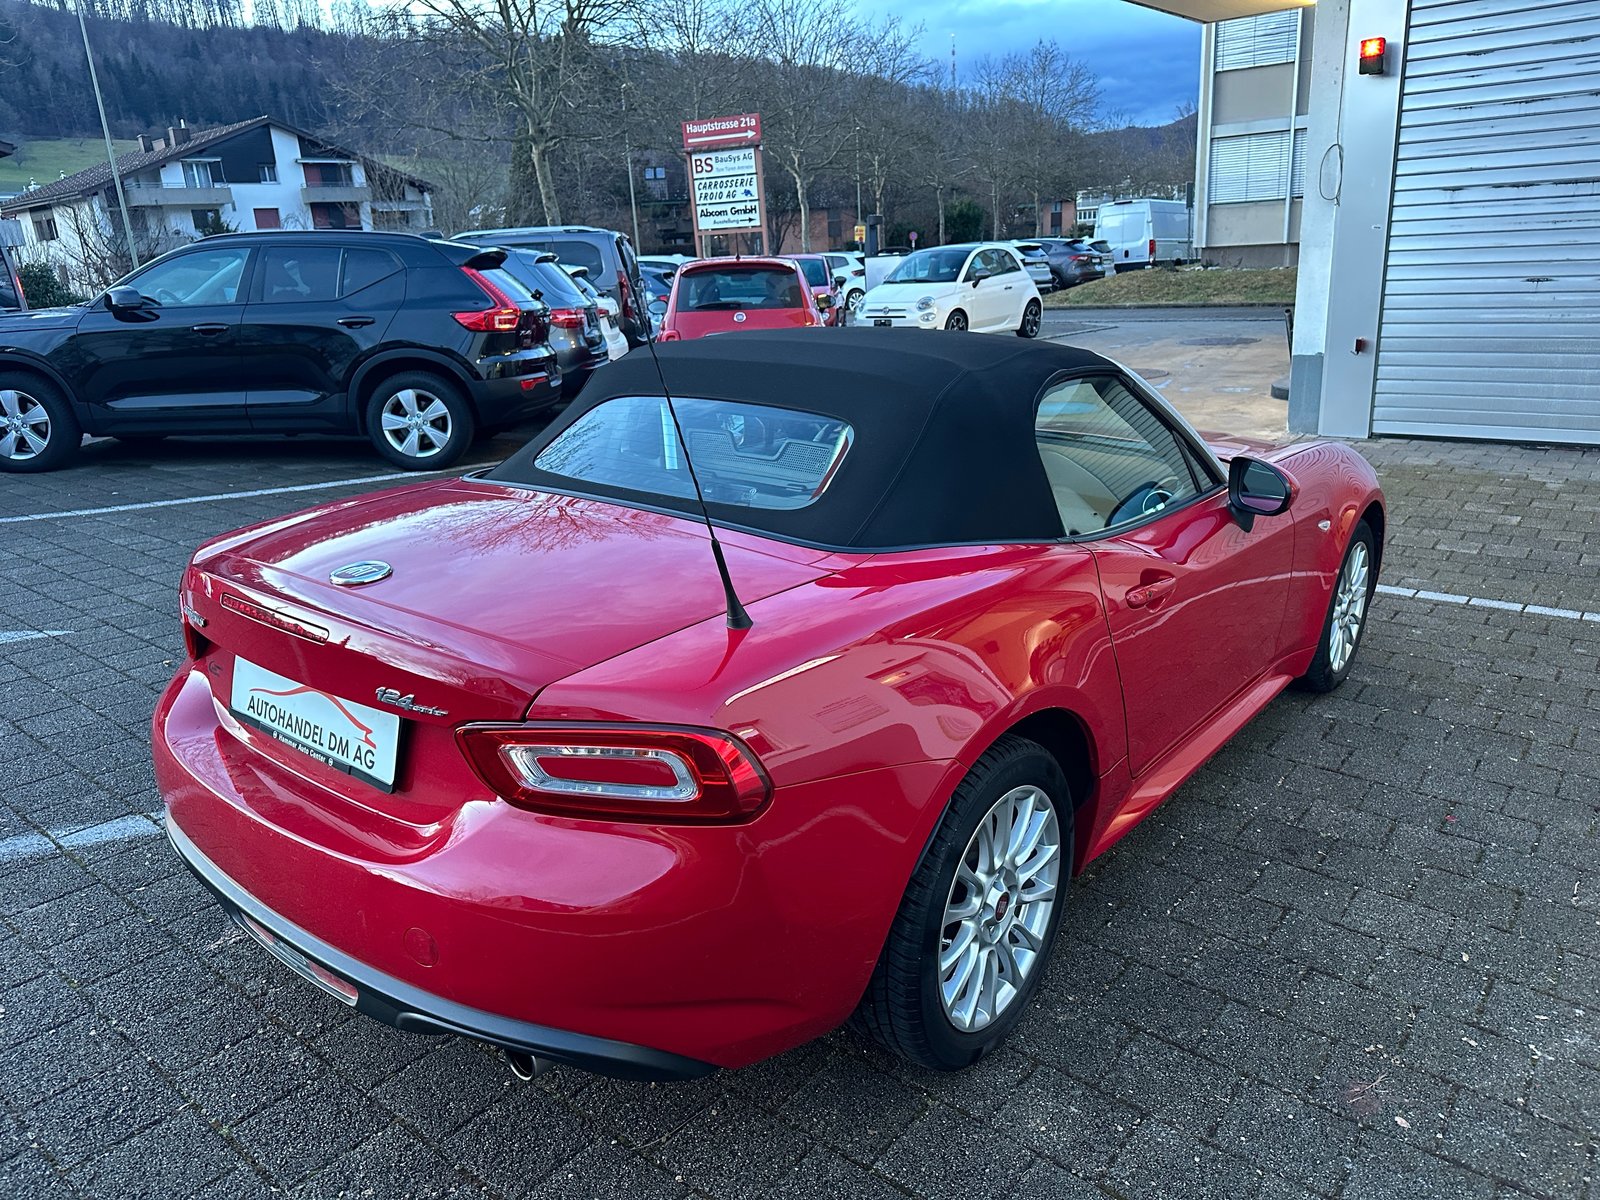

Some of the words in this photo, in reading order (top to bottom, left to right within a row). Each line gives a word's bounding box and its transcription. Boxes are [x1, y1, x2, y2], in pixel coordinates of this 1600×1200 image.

[686, 120, 739, 134] Hauptstrasse
[740, 117, 756, 127] 21a
[694, 157, 714, 174] BS
[714, 154, 740, 163] BauSys
[742, 152, 753, 161] AG
[697, 177, 754, 191] CARROSSERIE
[698, 191, 724, 201] FROIO
[726, 190, 737, 199] AG
[700, 208, 728, 218] Abcom
[730, 205, 757, 216] GmbH
[375, 686, 415, 710] 124
[247, 695, 324, 747] AUTOHANDEL
[327, 731, 350, 759] DM
[353, 745, 375, 770] AG
[298, 743, 309, 755] Auto
[310, 749, 326, 763] Center
